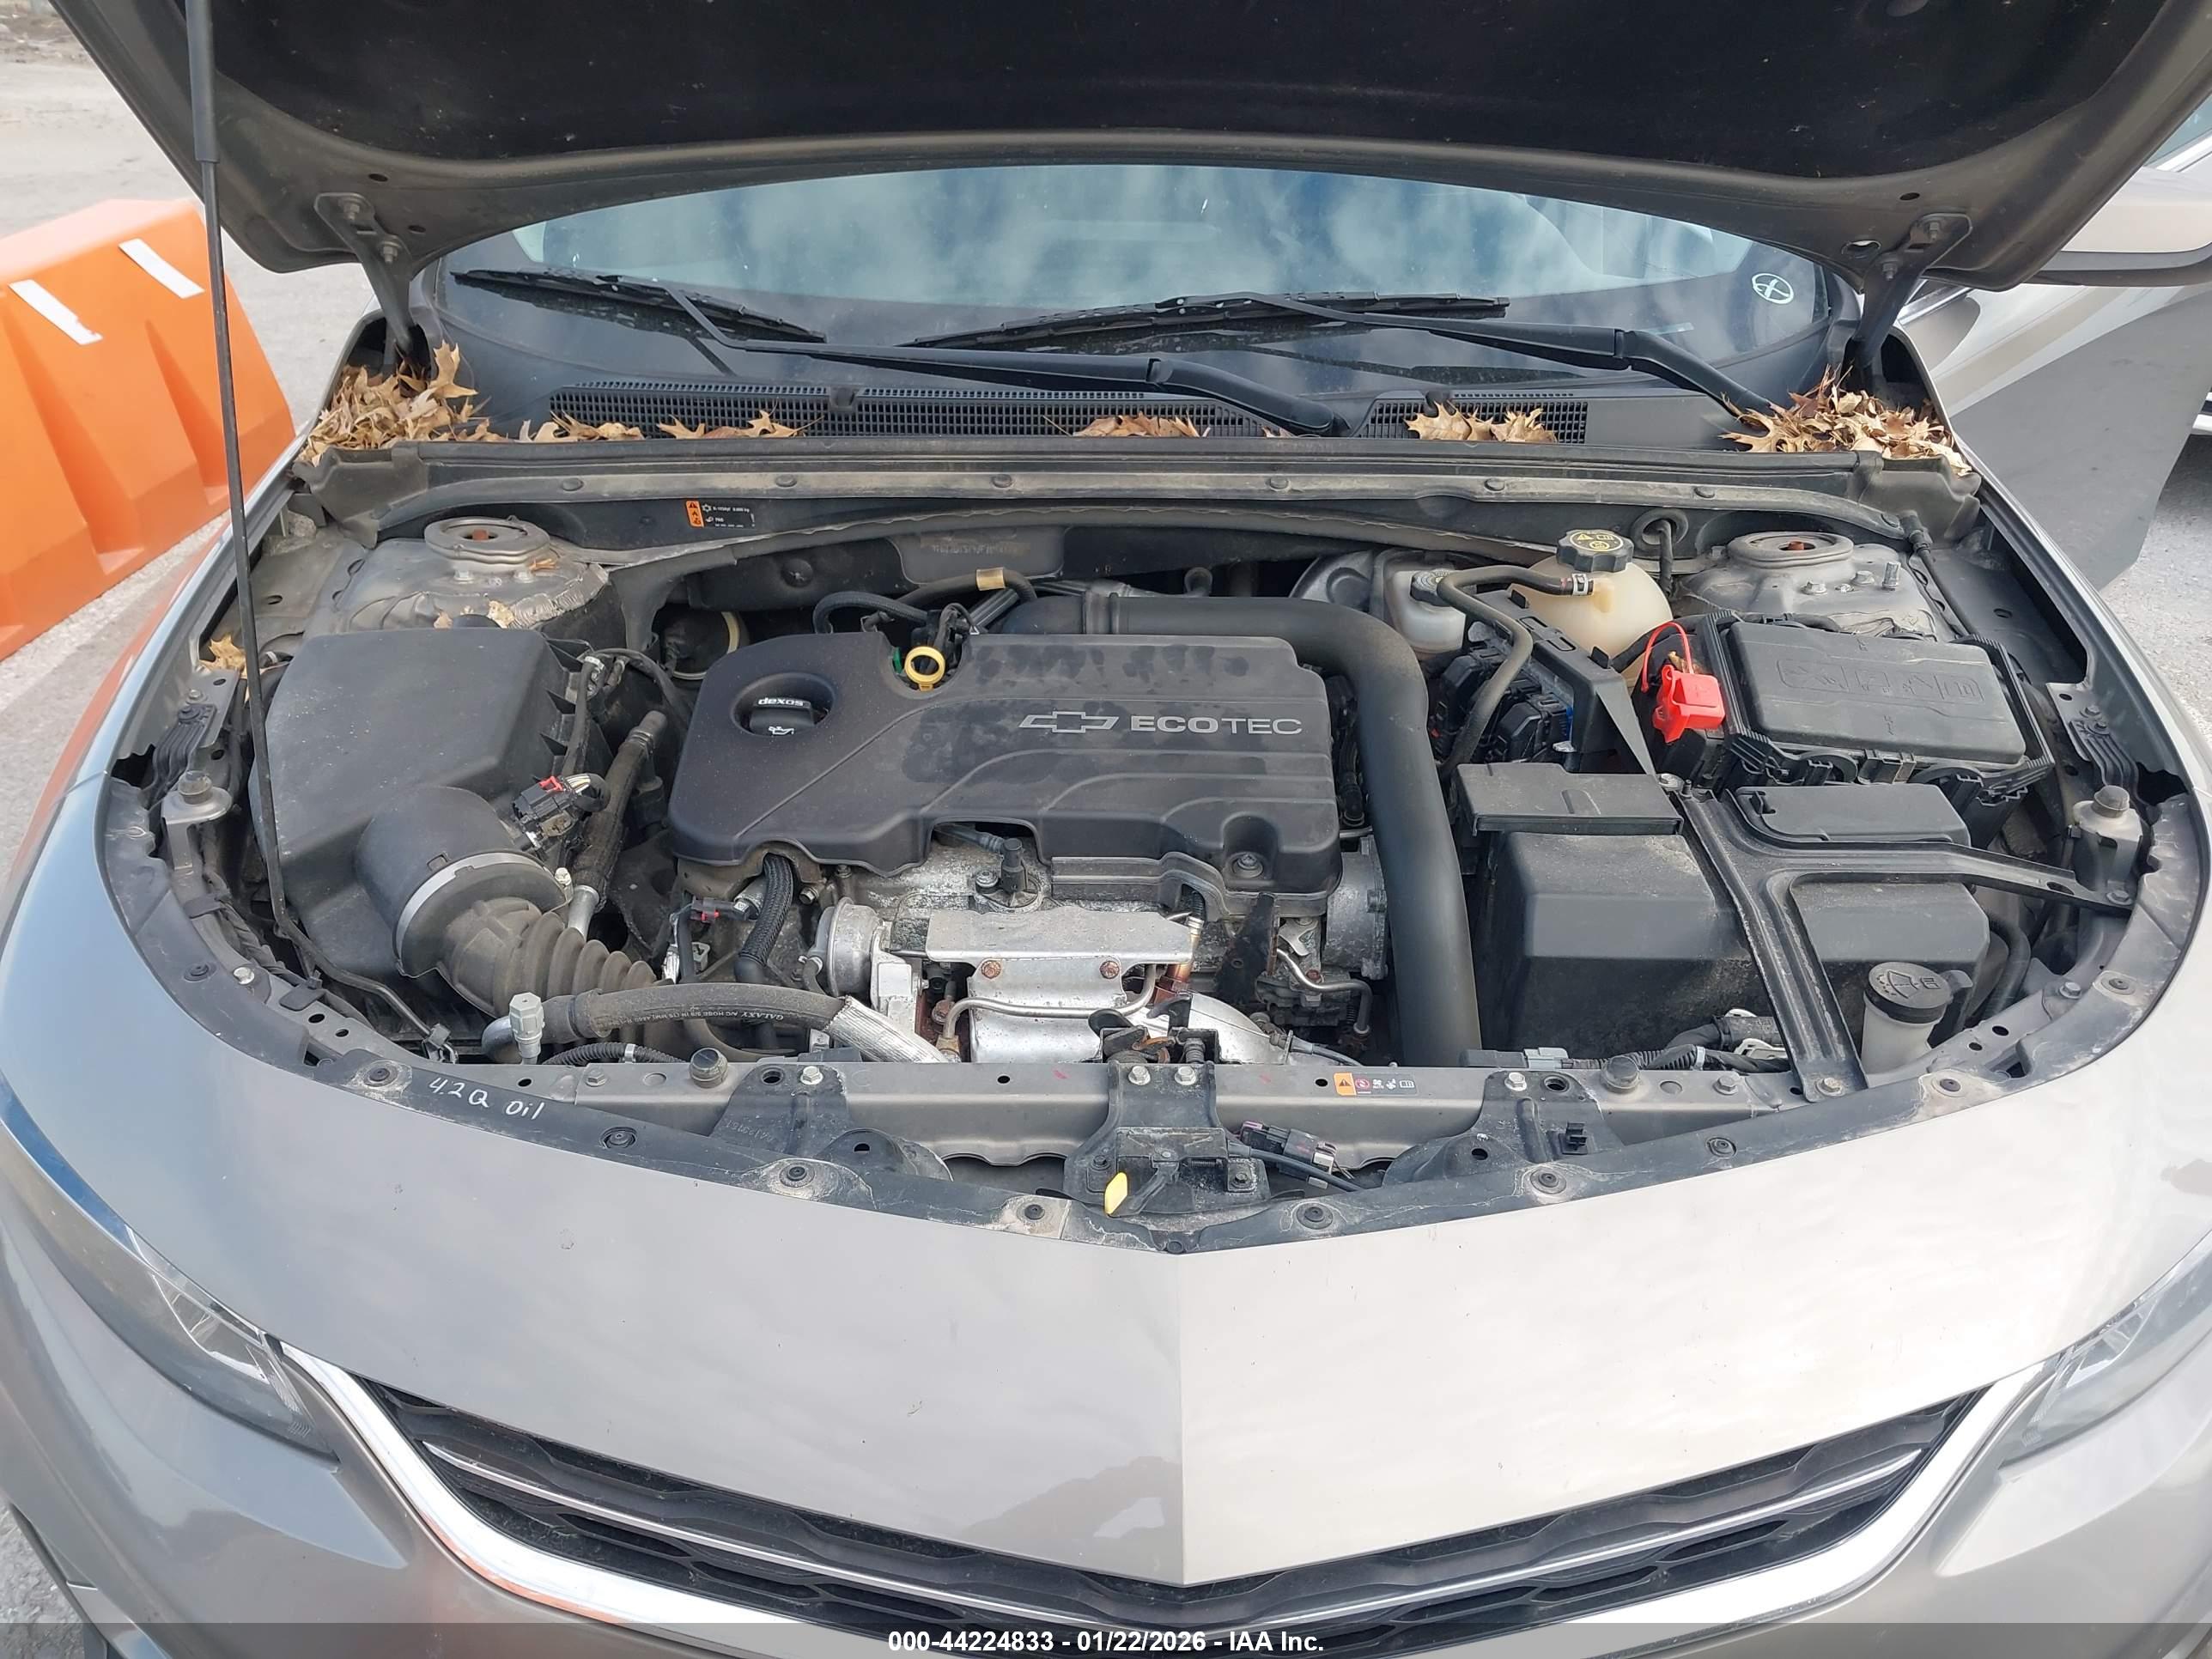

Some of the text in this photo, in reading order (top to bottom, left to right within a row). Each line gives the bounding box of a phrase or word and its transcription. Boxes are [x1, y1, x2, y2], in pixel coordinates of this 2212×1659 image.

[757, 697, 804, 707] dexos
[1130, 715, 1303, 735] ECOTEC
[740, 1012, 784, 1021] GALAXY
